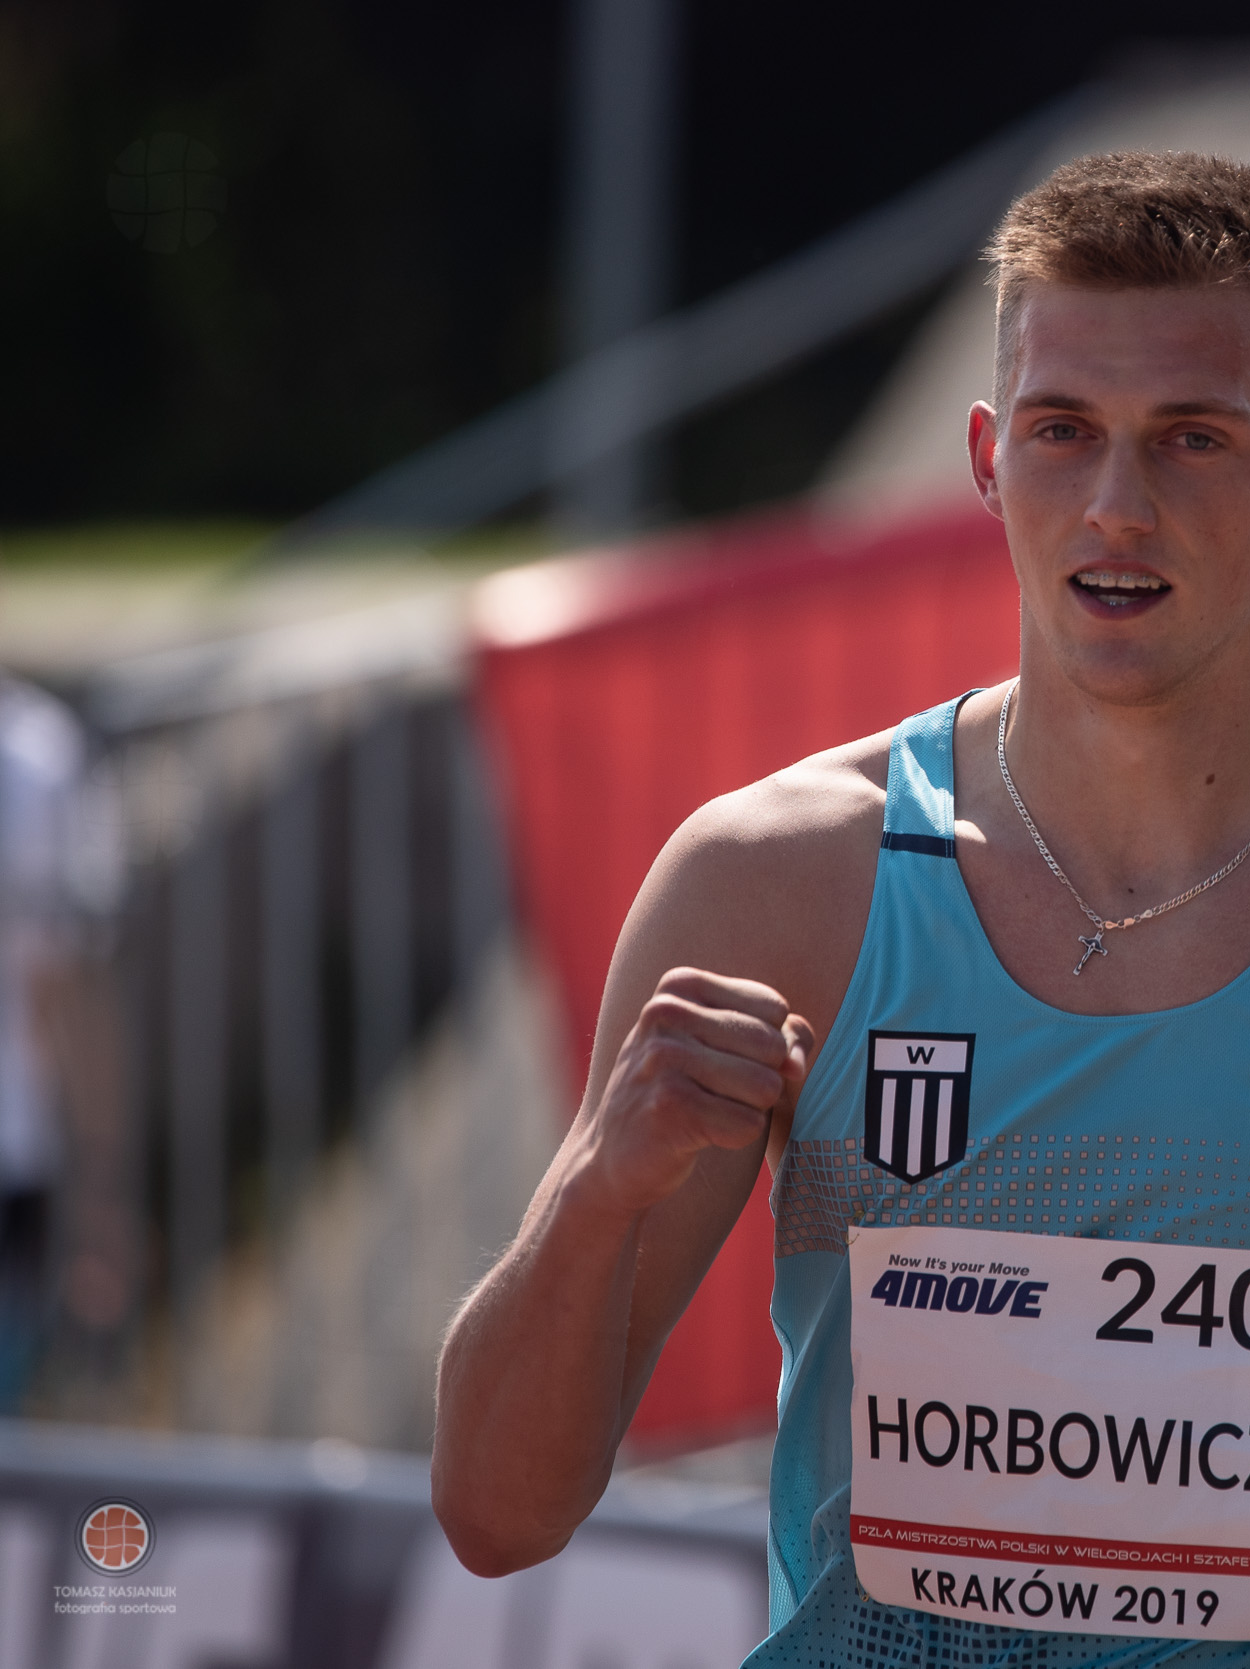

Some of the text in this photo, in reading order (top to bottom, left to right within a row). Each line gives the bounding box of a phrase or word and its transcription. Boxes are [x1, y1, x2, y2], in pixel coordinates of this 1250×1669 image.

[906, 1046, 935, 1065] W
[888, 1254, 1030, 1276] Now It's your Move
[870, 1269, 1049, 1318] 4MOVE
[858, 1525, 893, 1540] PZLA
[896, 1530, 998, 1550] MISTRZOSTWA
[1000, 1540, 1050, 1556] POLSKI
[1054, 1545, 1070, 1557] W
[1073, 1546, 1183, 1564] WIELOBOJACH
[910, 1567, 1220, 1627] KRAKÓW 2019
